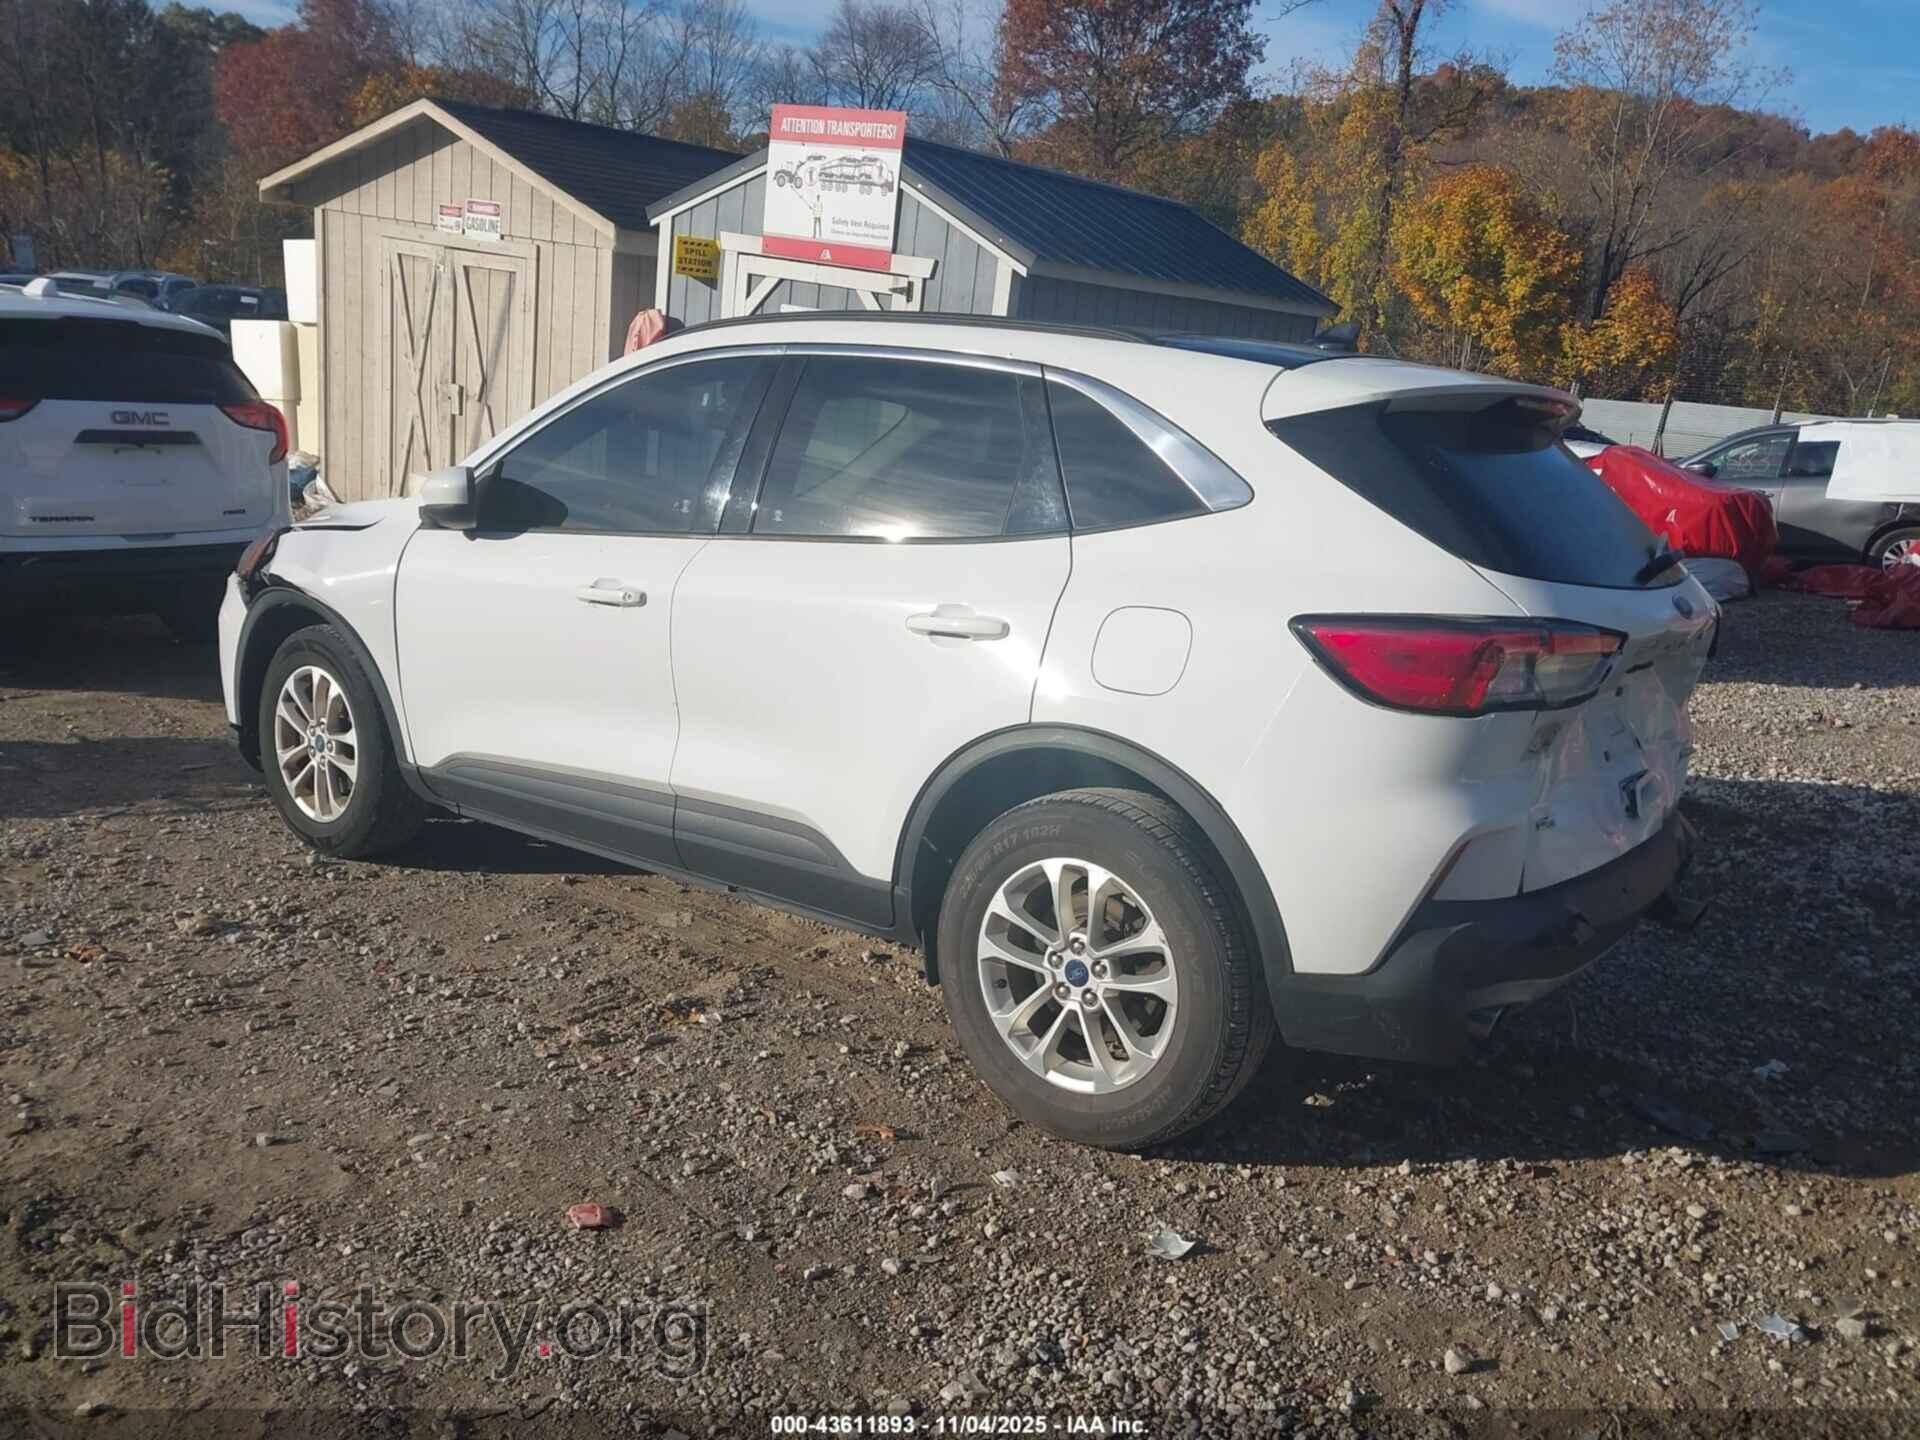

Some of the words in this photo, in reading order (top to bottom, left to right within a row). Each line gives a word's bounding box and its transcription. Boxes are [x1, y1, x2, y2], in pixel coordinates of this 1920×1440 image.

[781, 117, 825, 135] ATTENTION
[827, 119, 897, 140] TRANSPORTERS!
[465, 215, 499, 234] GASOLINE
[684, 248, 707, 256] SPILL
[678, 256, 712, 267] STATION
[111, 410, 170, 426] GMC
